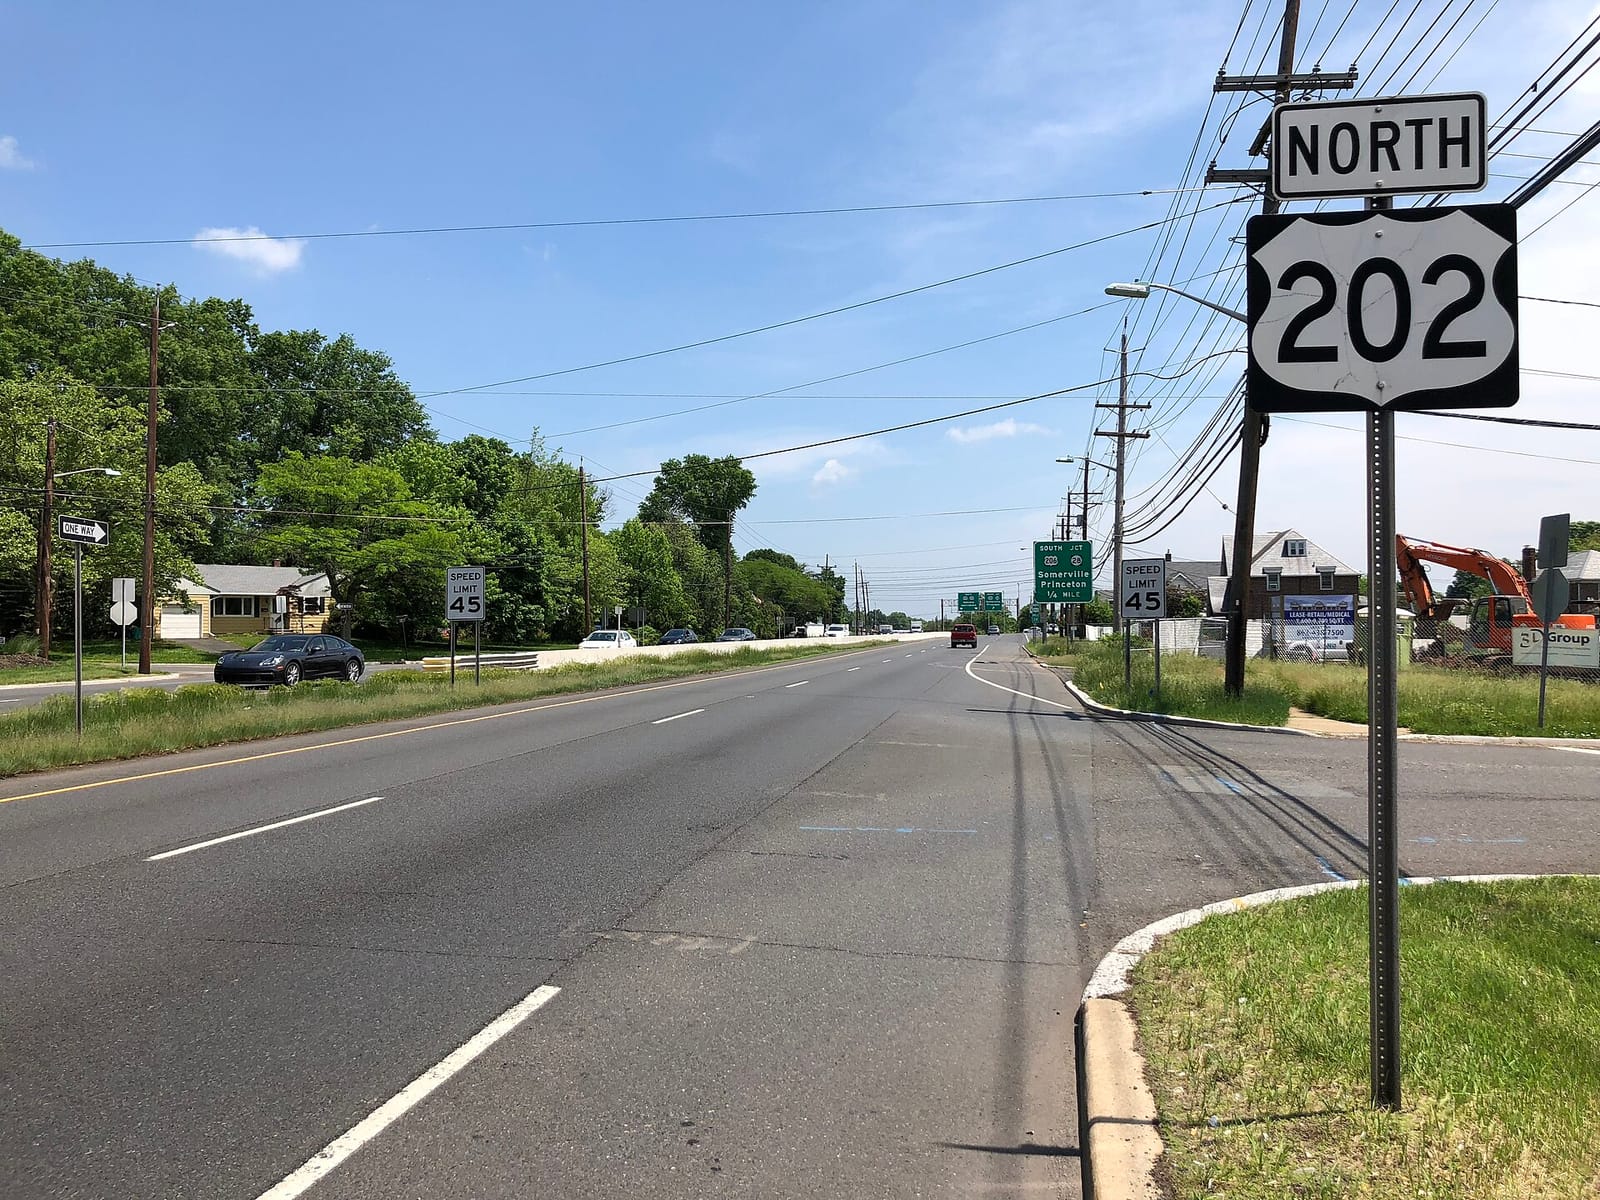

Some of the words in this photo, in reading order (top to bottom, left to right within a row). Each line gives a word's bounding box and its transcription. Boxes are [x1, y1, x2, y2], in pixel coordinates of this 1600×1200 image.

[1288, 116, 1470, 176] NORTH
[1277, 253, 1487, 364] 202
[65, 523, 79, 533] ONE
[80, 525, 95, 536] WAY
[450, 572, 481, 580] SPEED
[1126, 565, 1161, 575] SPEED
[453, 585, 478, 593] LIMIT
[1129, 579, 1157, 588] LIMIT
[450, 596, 481, 613] 45
[1125, 592, 1161, 611] 45
[1548, 632, 1590, 646] Group
